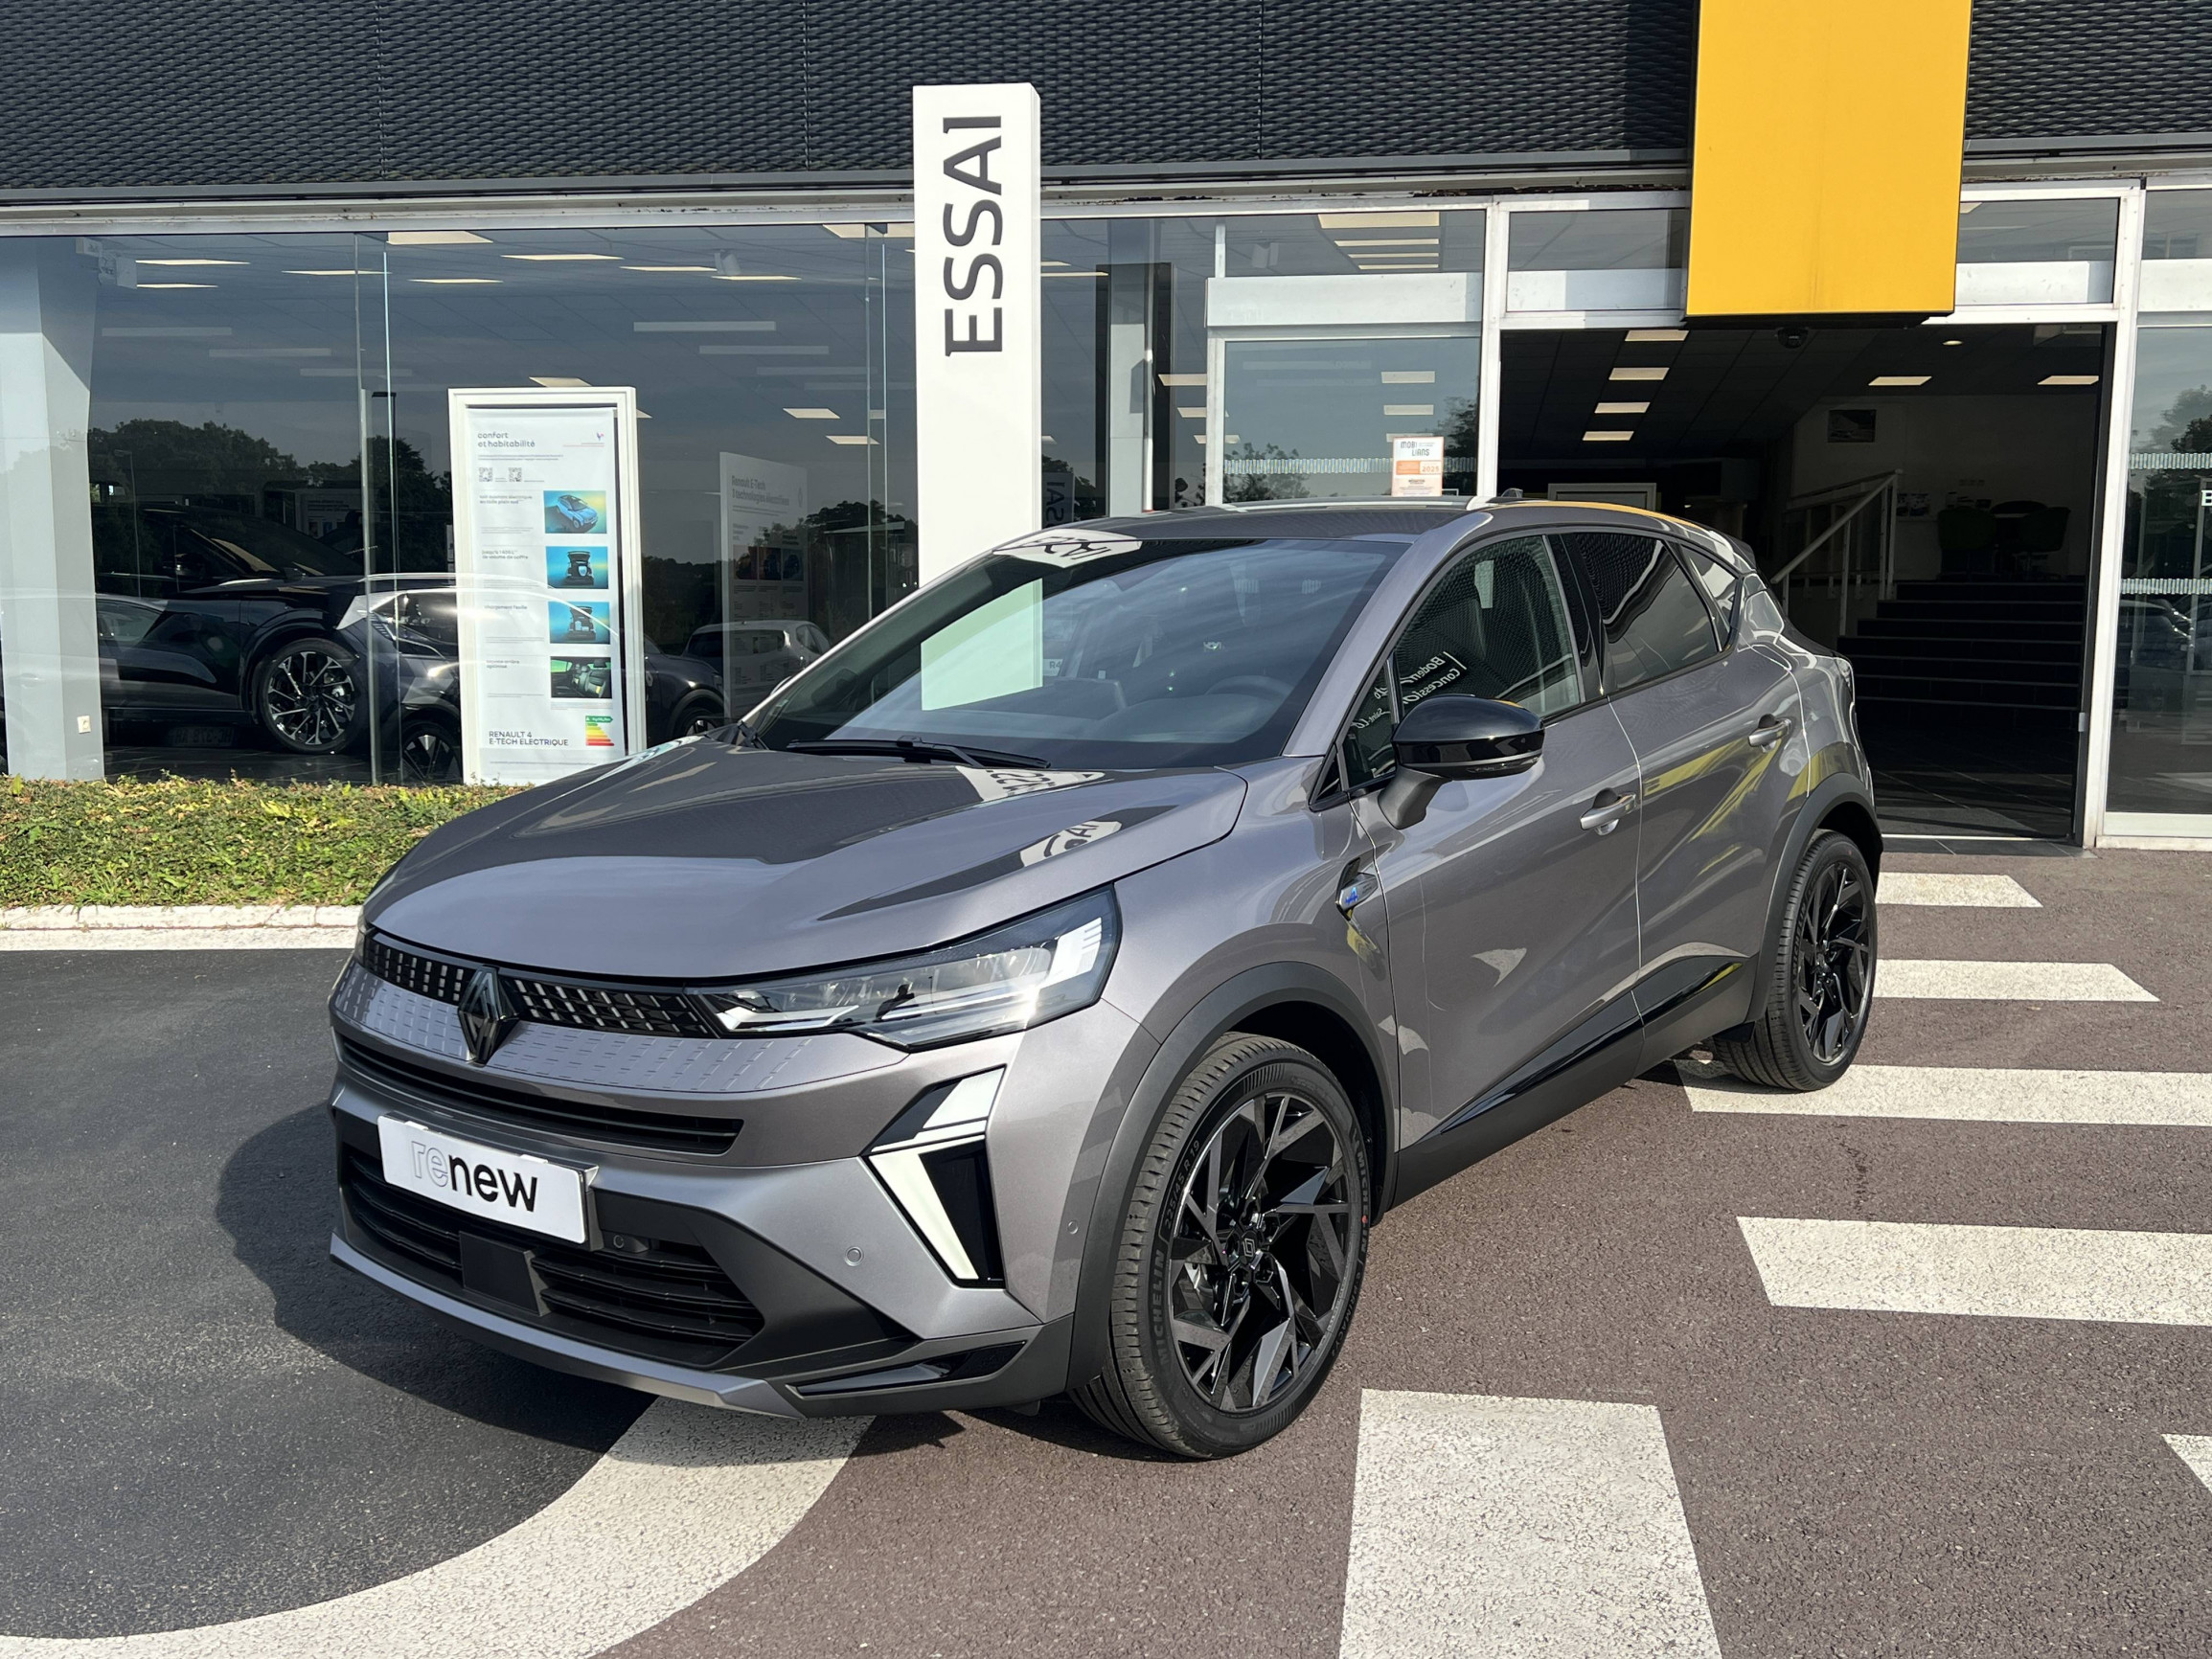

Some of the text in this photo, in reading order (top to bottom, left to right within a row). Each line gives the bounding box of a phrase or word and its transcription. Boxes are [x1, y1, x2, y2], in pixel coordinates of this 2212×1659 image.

[943, 116, 1003, 357] ESSAI
[488, 440, 536, 448] habitabilité
[411, 1140, 538, 1213] renew
[1183, 1159, 1191, 1170] R
[1190, 1140, 1200, 1157] 19
[1152, 1249, 1169, 1365] MICHELIN
